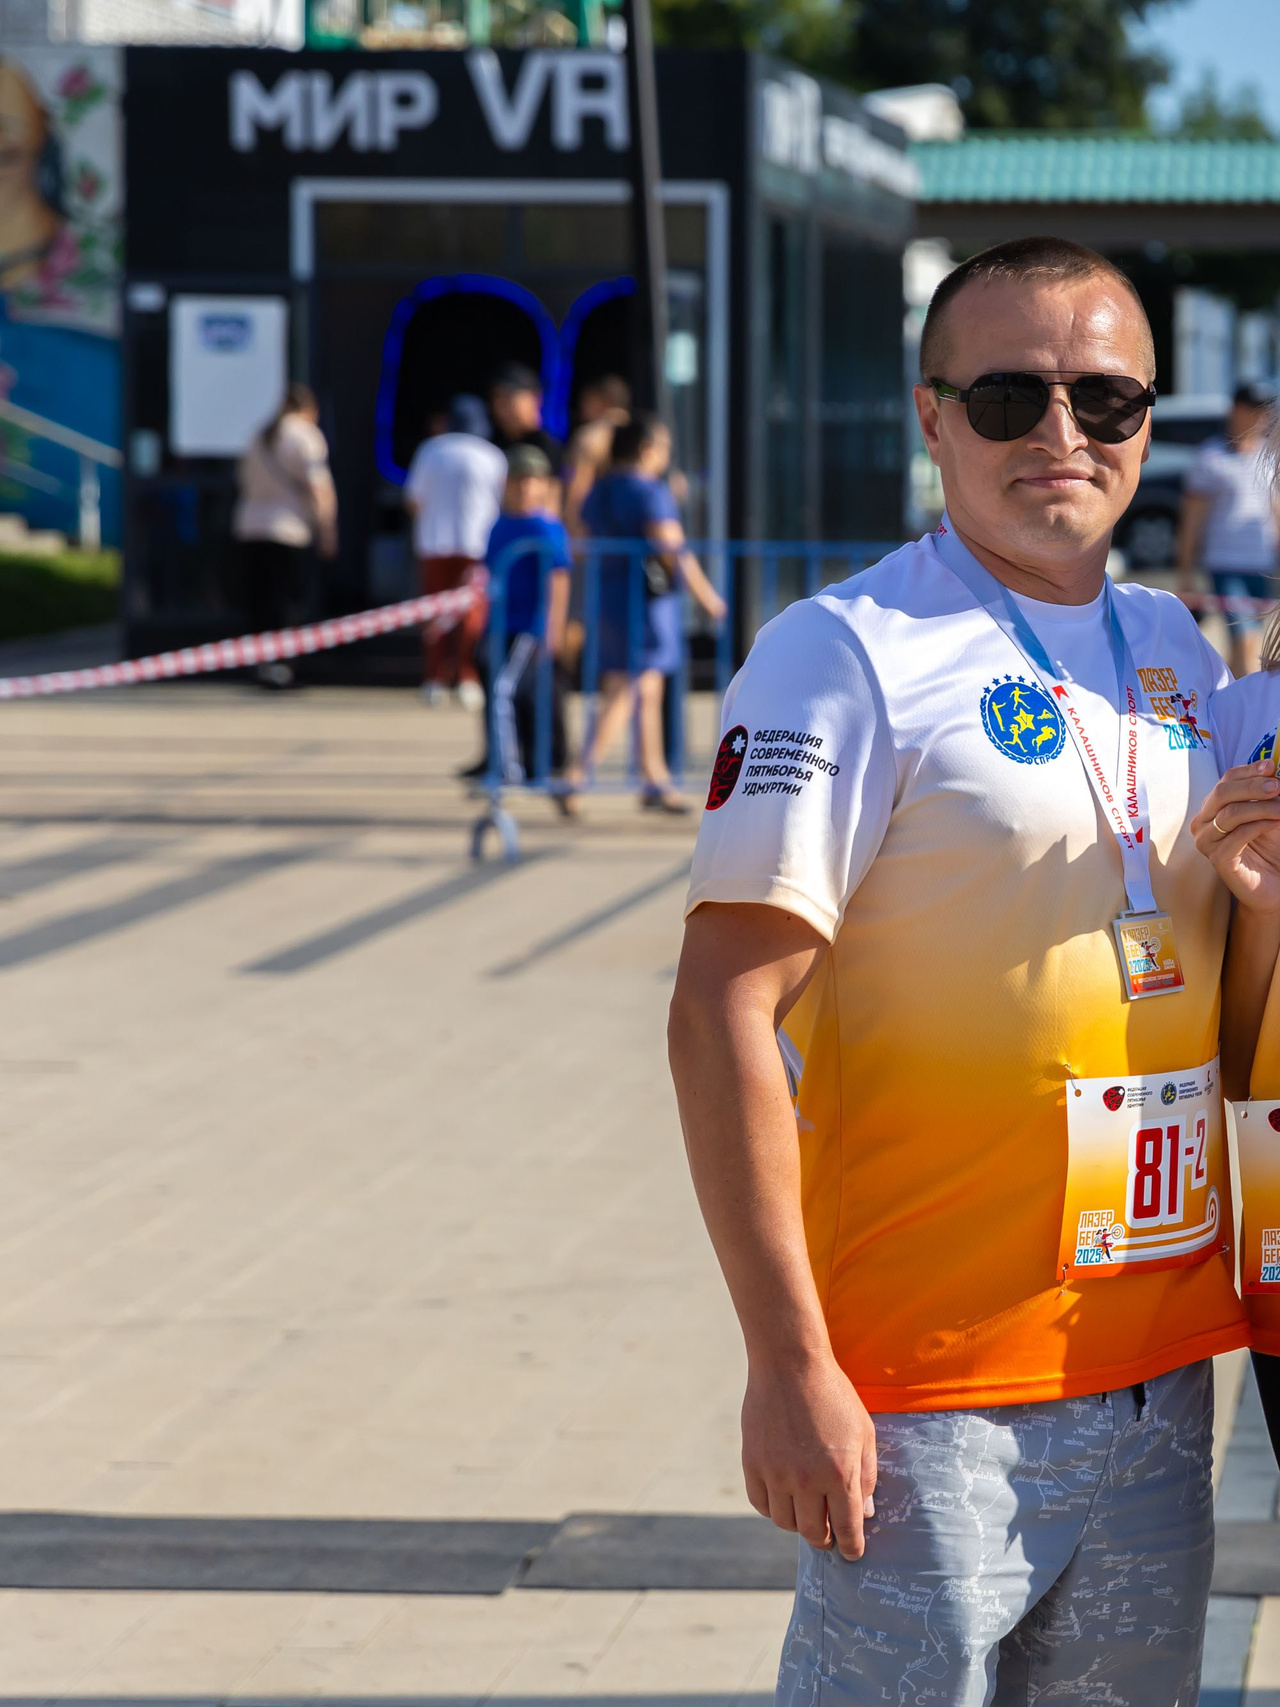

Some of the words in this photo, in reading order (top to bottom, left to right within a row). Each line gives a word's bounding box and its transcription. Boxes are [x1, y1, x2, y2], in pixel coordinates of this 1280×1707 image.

[229, 69, 439, 153] МИР
[1136, 666, 1178, 693] ЛАЗЕР
[1126, 685, 1138, 726] СПОРТ
[753, 730, 823, 749] ФЕДЕРАЦИЯ
[1163, 724, 1197, 750] 2025
[750, 747, 840, 776] СОВРЕМЕННОГО
[1025, 753, 1051, 765] ФСПР
[745, 765, 813, 782] ПЯТИБОРЬЯ
[1067, 706, 1114, 804] КАЛАШНИКОВ
[1111, 806, 1135, 850] СПОРТ
[1126, 730, 1139, 818] КАЛАШНИКОВ
[742, 782, 803, 796] УДМУРТИИ
[1130, 943, 1142, 958] БЕ
[1132, 1117, 1206, 1220] 81-2
[1080, 1211, 1113, 1228] ЛАЗЕР
[1076, 1248, 1102, 1264] 2025
